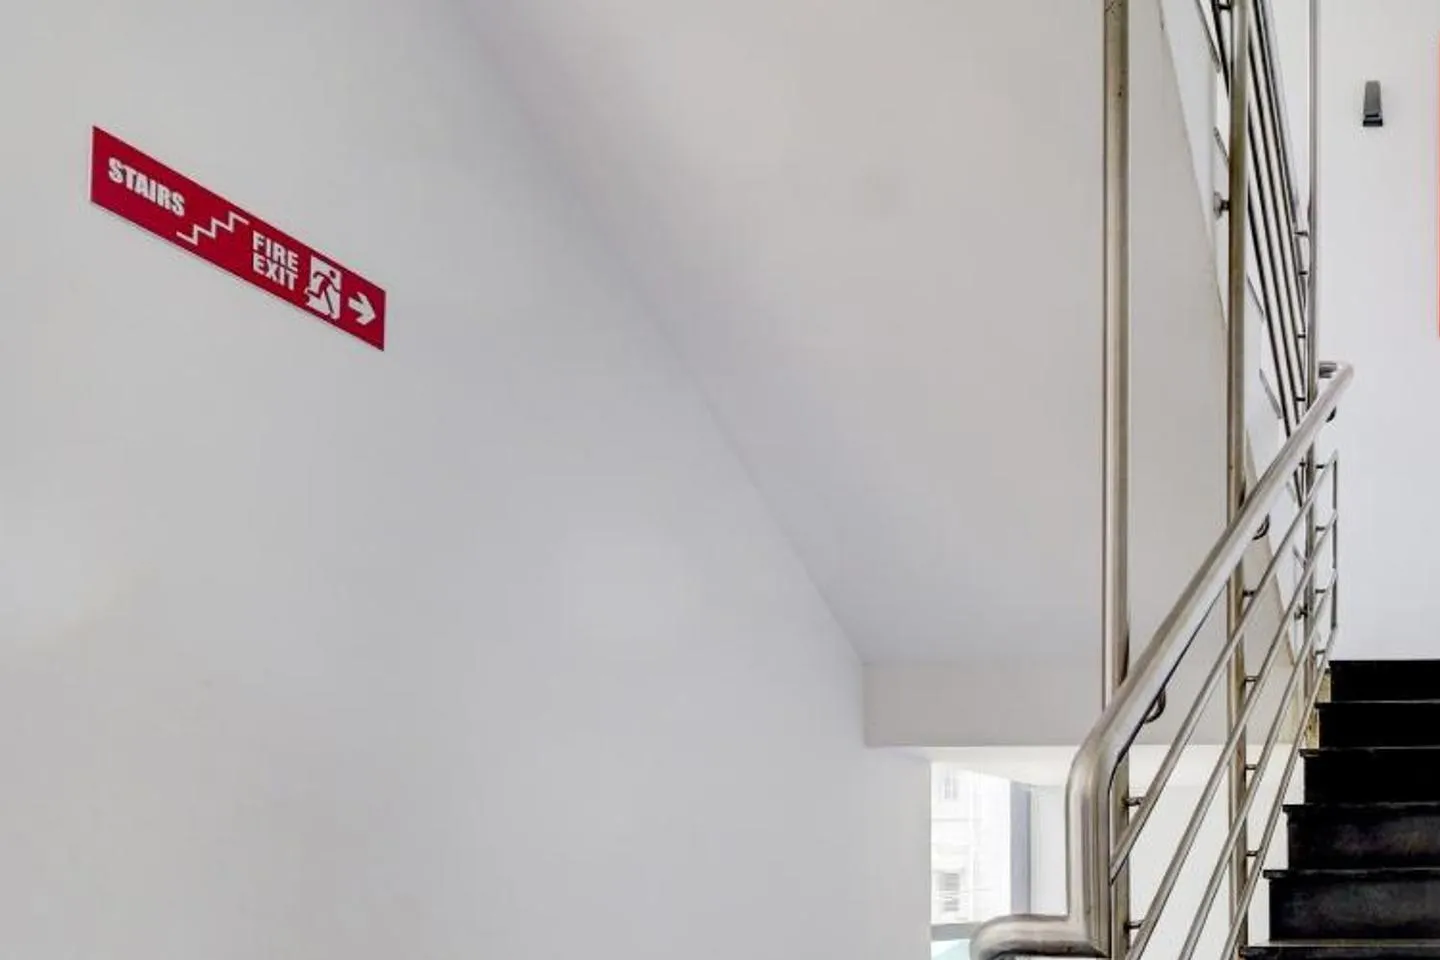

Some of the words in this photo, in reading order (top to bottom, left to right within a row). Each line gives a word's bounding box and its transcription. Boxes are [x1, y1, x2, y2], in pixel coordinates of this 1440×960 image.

[108, 157, 185, 217] STAIRS
[252, 230, 300, 272] FIRE
[252, 254, 299, 290] EXIT
